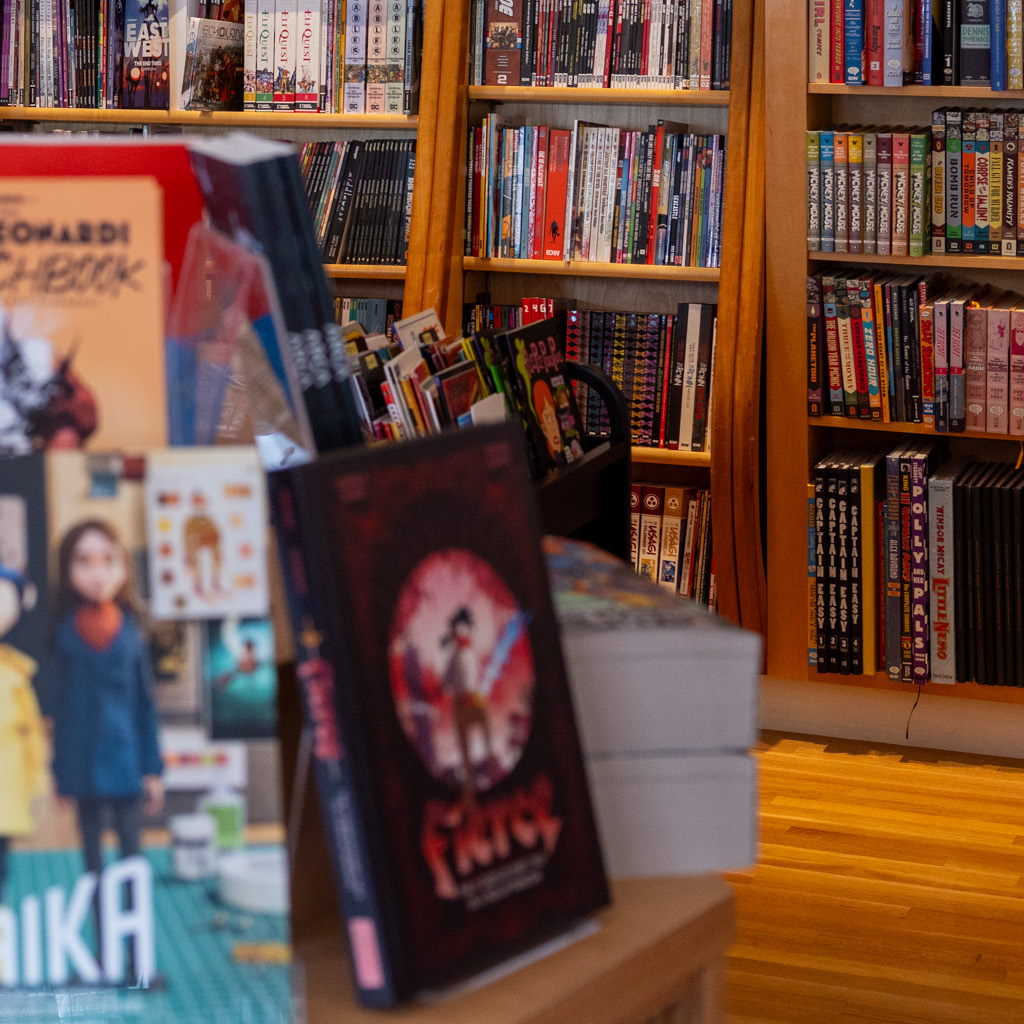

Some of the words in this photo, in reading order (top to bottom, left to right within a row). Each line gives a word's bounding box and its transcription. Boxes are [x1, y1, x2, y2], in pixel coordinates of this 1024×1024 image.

[962, 26, 989, 36] DENNIS
[950, 158, 958, 187] BOMB
[950, 191, 958, 219] RUN
[546, 249, 560, 257] IDW
[864, 328, 874, 356] ZERO
[867, 360, 877, 387] HOUR
